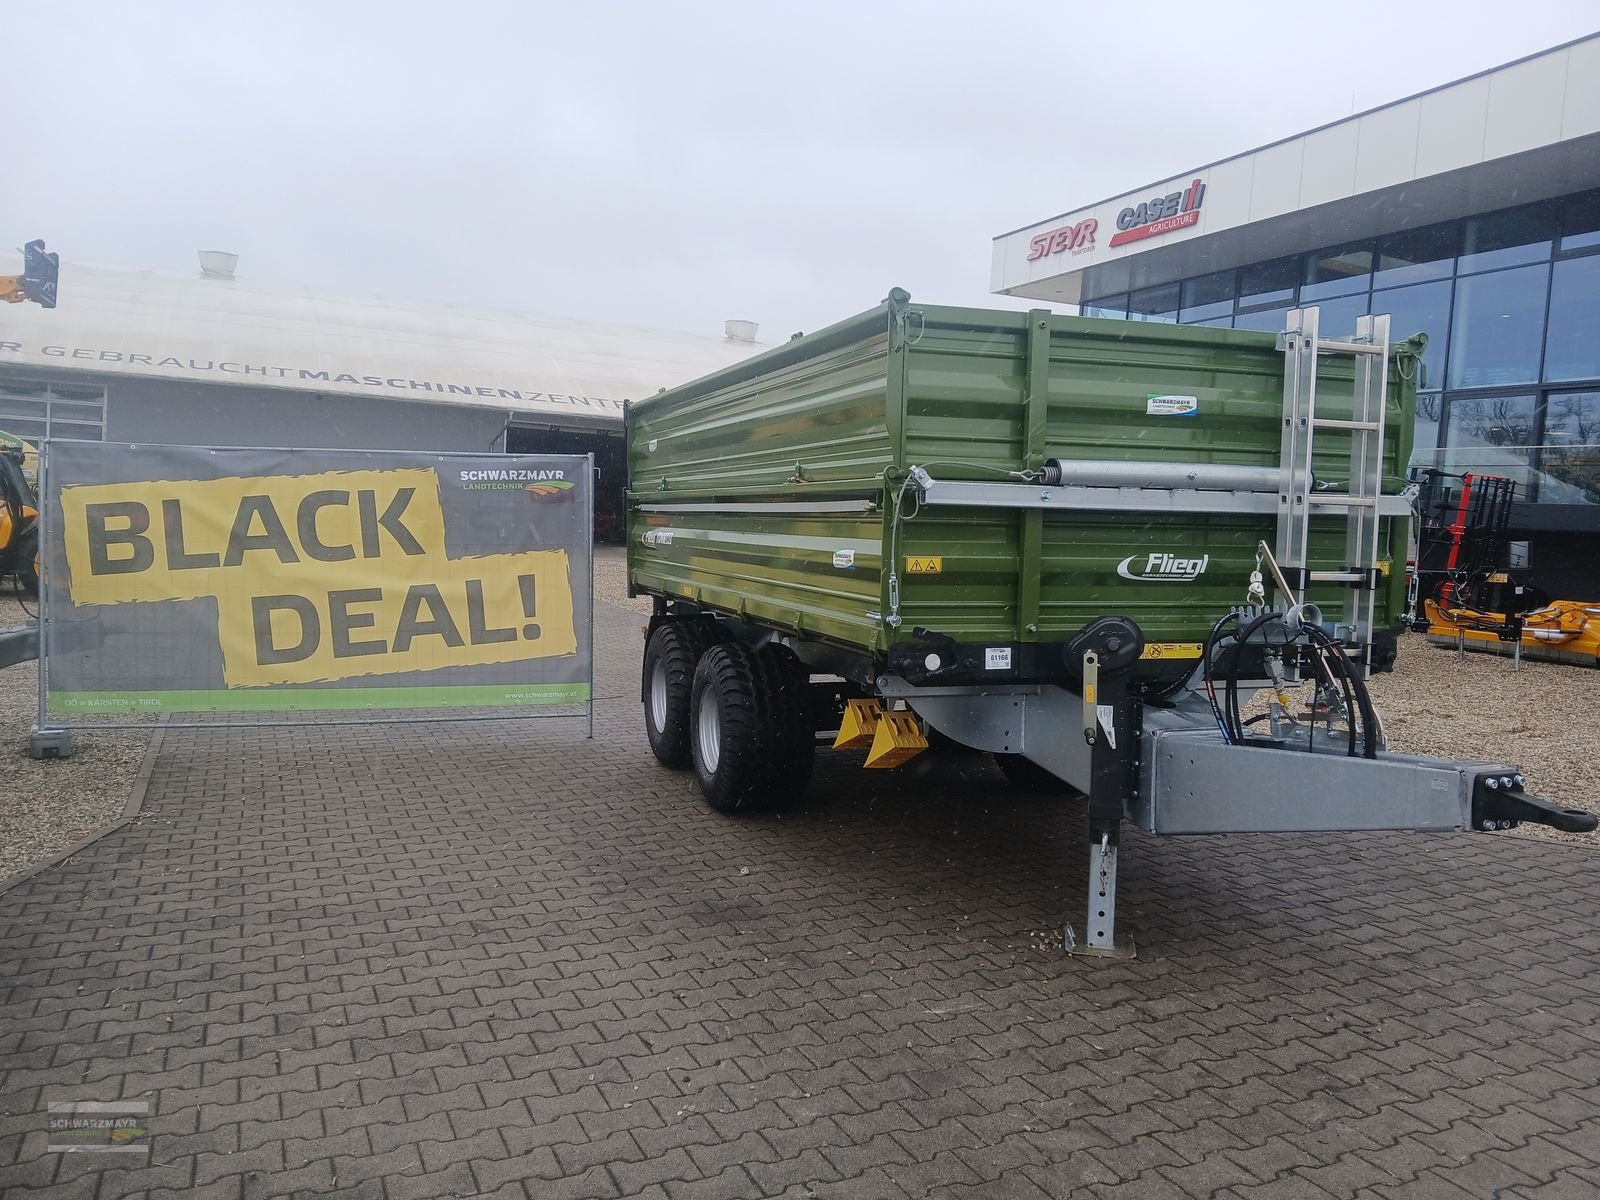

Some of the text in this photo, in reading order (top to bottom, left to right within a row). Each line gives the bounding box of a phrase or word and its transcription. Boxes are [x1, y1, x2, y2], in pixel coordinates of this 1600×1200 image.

[1148, 212, 1195, 234] AGRICULTURE
[1026, 218, 1099, 262] STEYR
[460, 470, 564, 481] SCHWARZMAYR
[85, 487, 426, 576] BLACK
[1145, 553, 1209, 578] Fliegl
[250, 573, 542, 666] DEAL!
[504, 690, 577, 700] www.schwarzmayr.at
